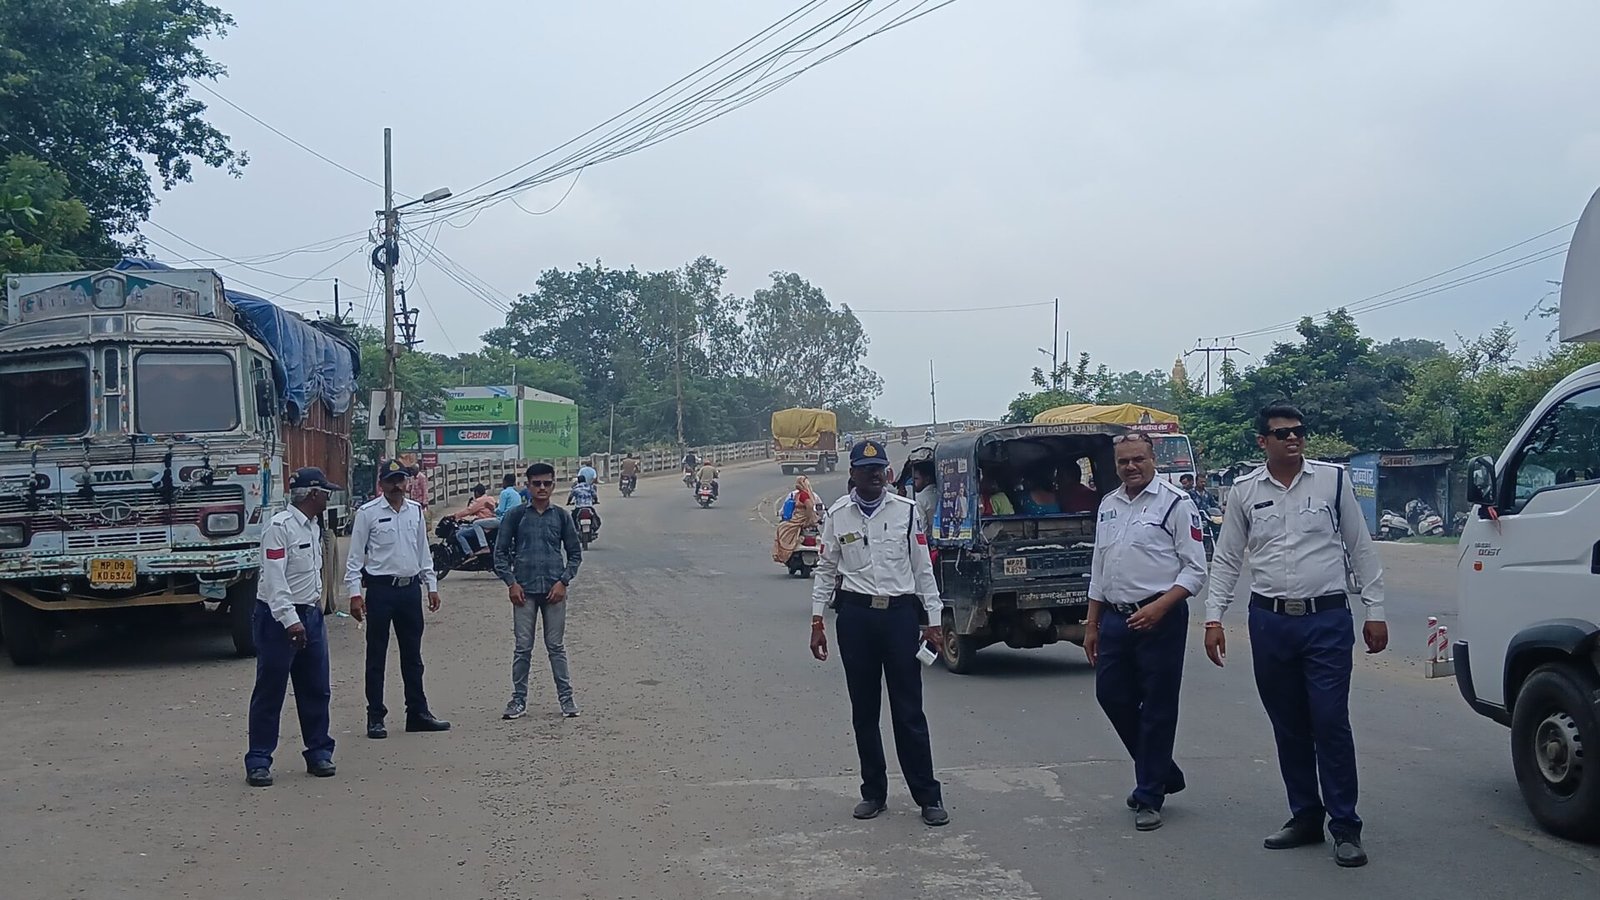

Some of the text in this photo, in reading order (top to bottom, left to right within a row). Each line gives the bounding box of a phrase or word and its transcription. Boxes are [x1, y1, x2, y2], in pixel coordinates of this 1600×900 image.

[1047, 425, 1069, 433] GOLD
[466, 430, 491, 439] Castrol
[94, 470, 133, 482] TATA
[100, 561, 111, 570] MP
